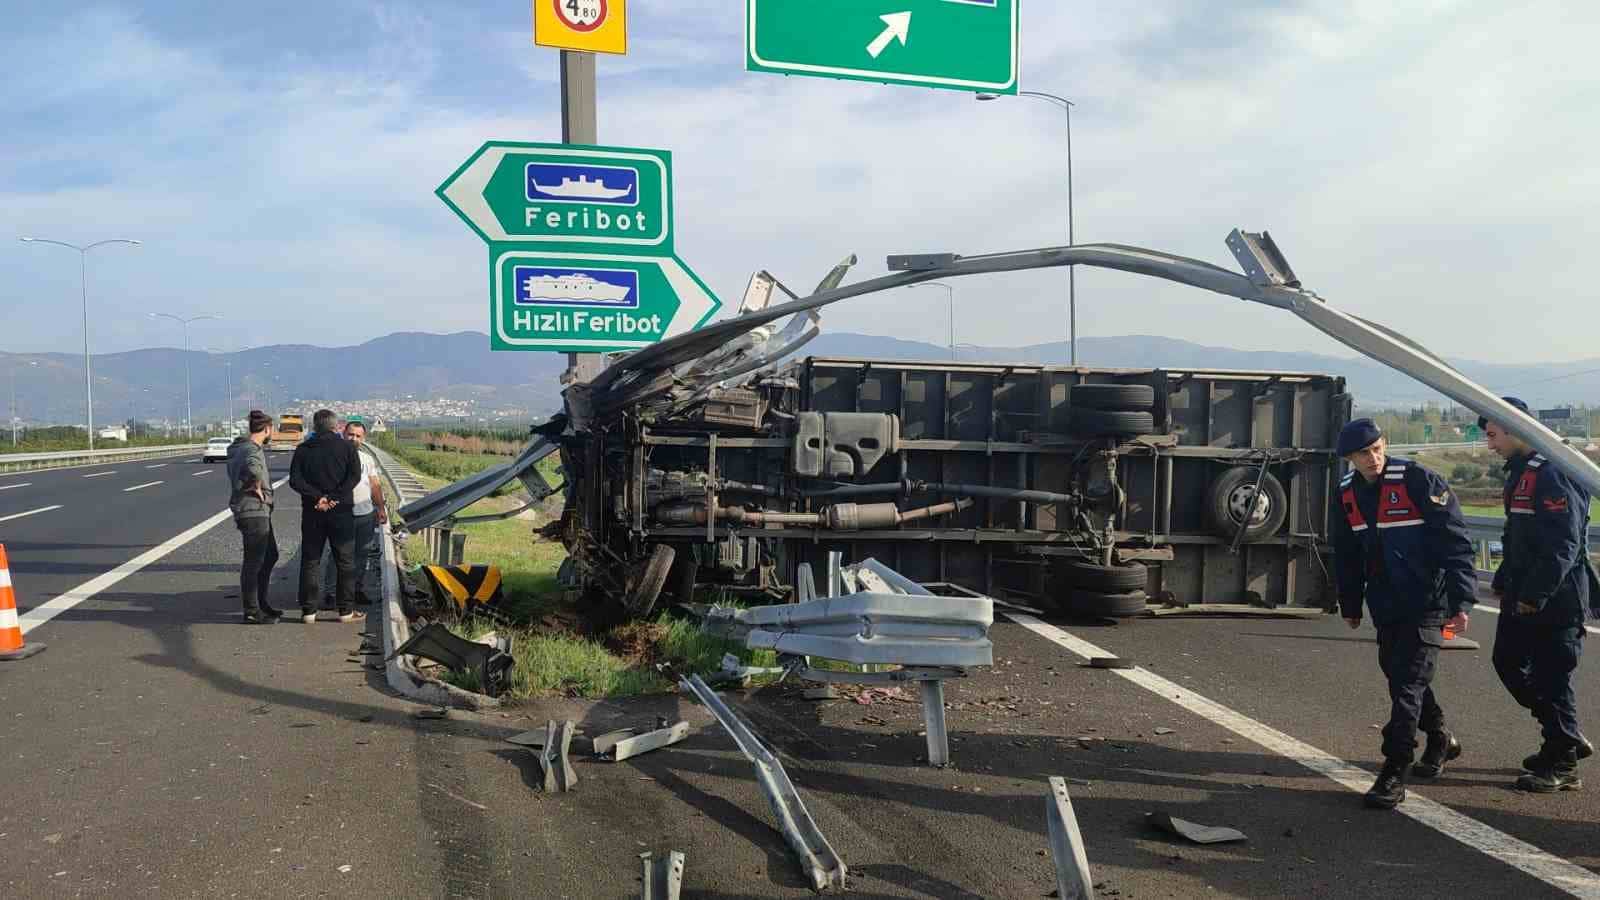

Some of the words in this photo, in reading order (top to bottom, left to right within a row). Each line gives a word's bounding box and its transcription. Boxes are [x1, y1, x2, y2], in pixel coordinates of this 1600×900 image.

[525, 207, 646, 231] Feribot
[513, 310, 569, 332] Hızlı
[573, 311, 661, 334] Feribot
